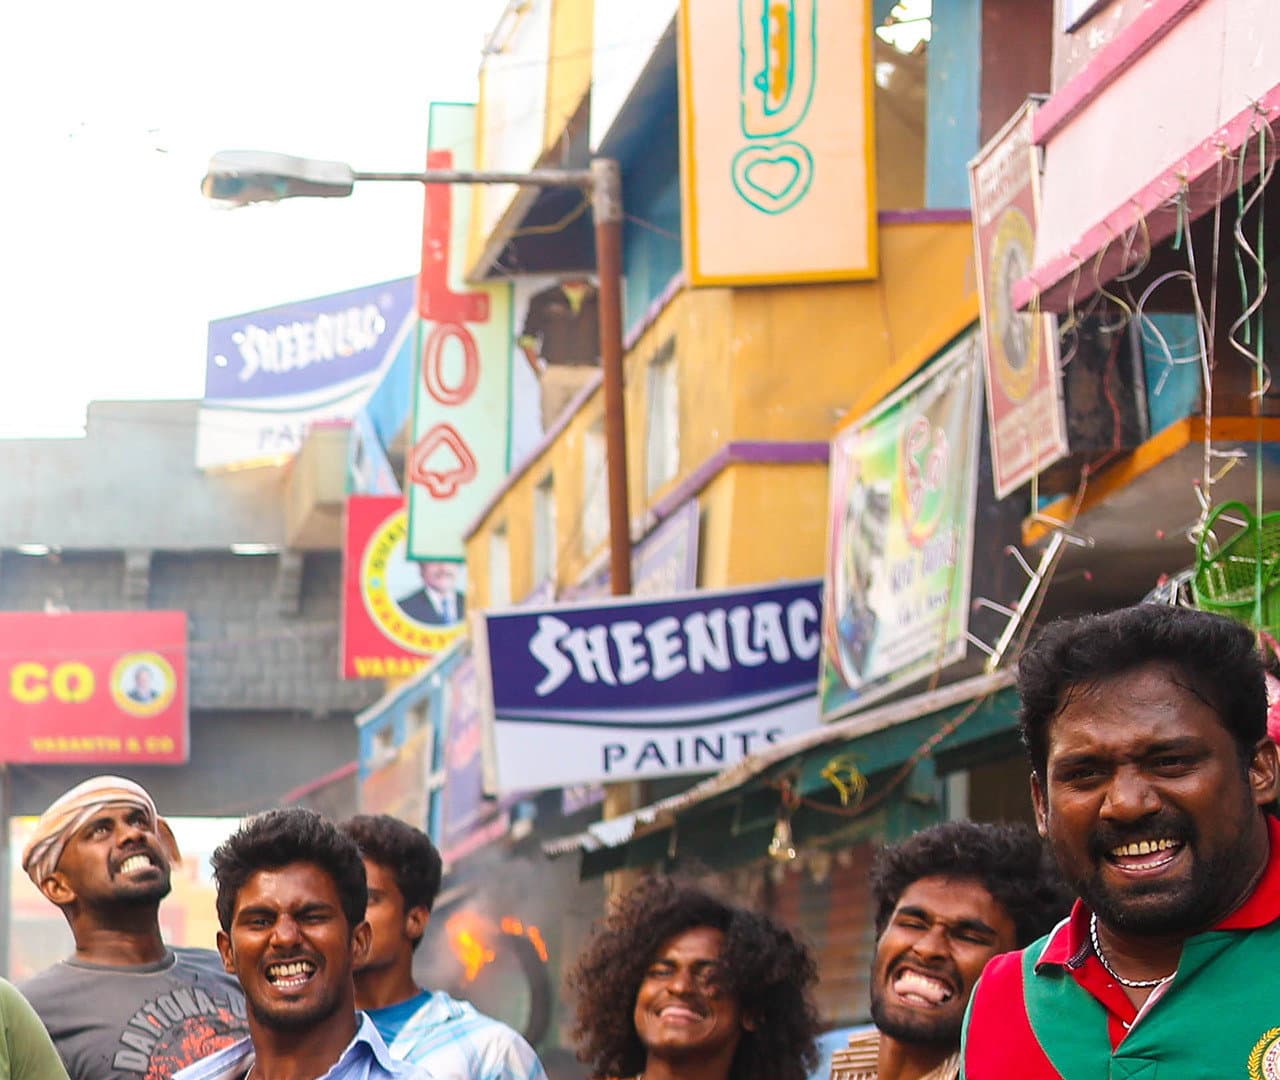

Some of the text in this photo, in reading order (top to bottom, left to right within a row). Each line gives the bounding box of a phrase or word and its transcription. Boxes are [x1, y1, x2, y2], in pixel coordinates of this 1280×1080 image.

[529, 597, 822, 696] SHEENLAC
[9, 661, 96, 704] CO
[31, 737, 122, 754] VASANTH
[145, 735, 176, 754] CO
